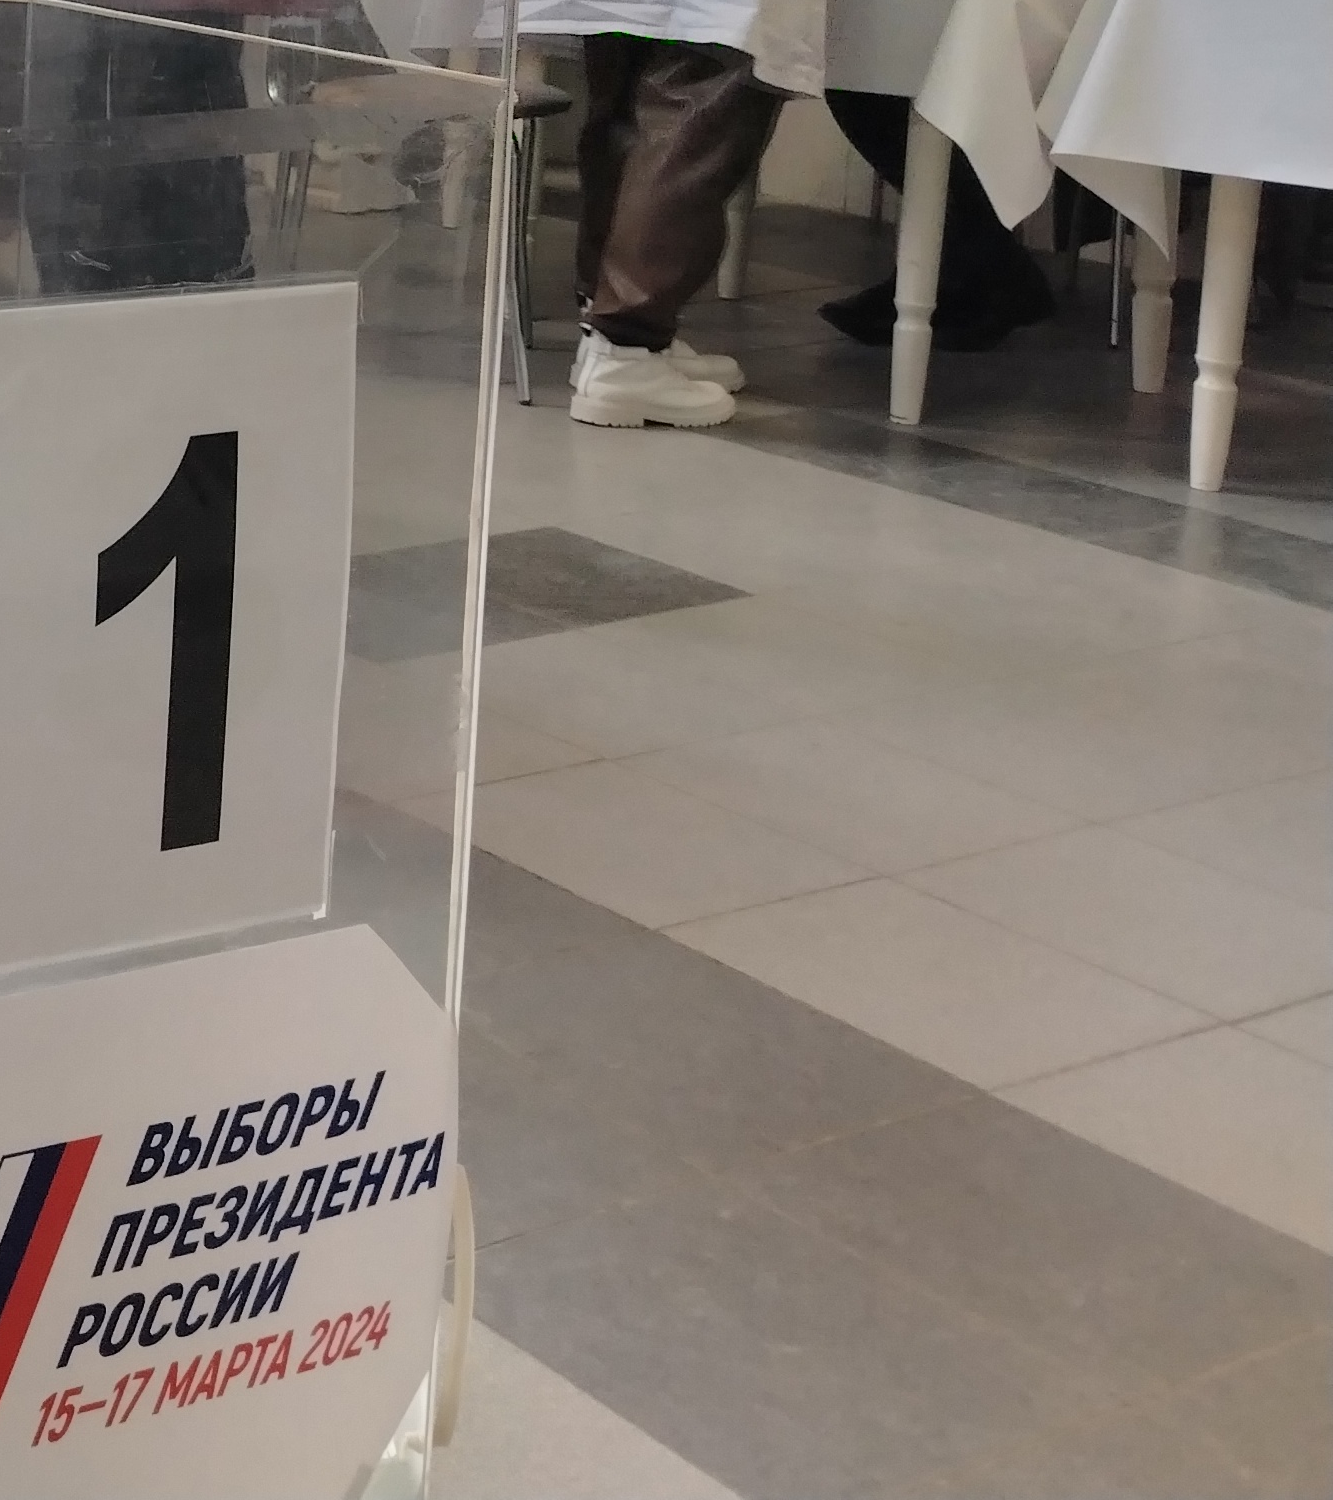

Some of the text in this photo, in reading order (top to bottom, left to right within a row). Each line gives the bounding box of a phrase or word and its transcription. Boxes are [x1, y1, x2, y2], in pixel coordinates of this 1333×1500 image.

[95, 430, 239, 852] 1
[126, 1070, 387, 1187] ВЫБОРЫ
[91, 1131, 446, 1278] ПРЕЗИДЕНТА
[56, 1251, 301, 1369] РОССИИ
[151, 1329, 294, 1415] МАРТА
[296, 1300, 391, 1374] 2024
